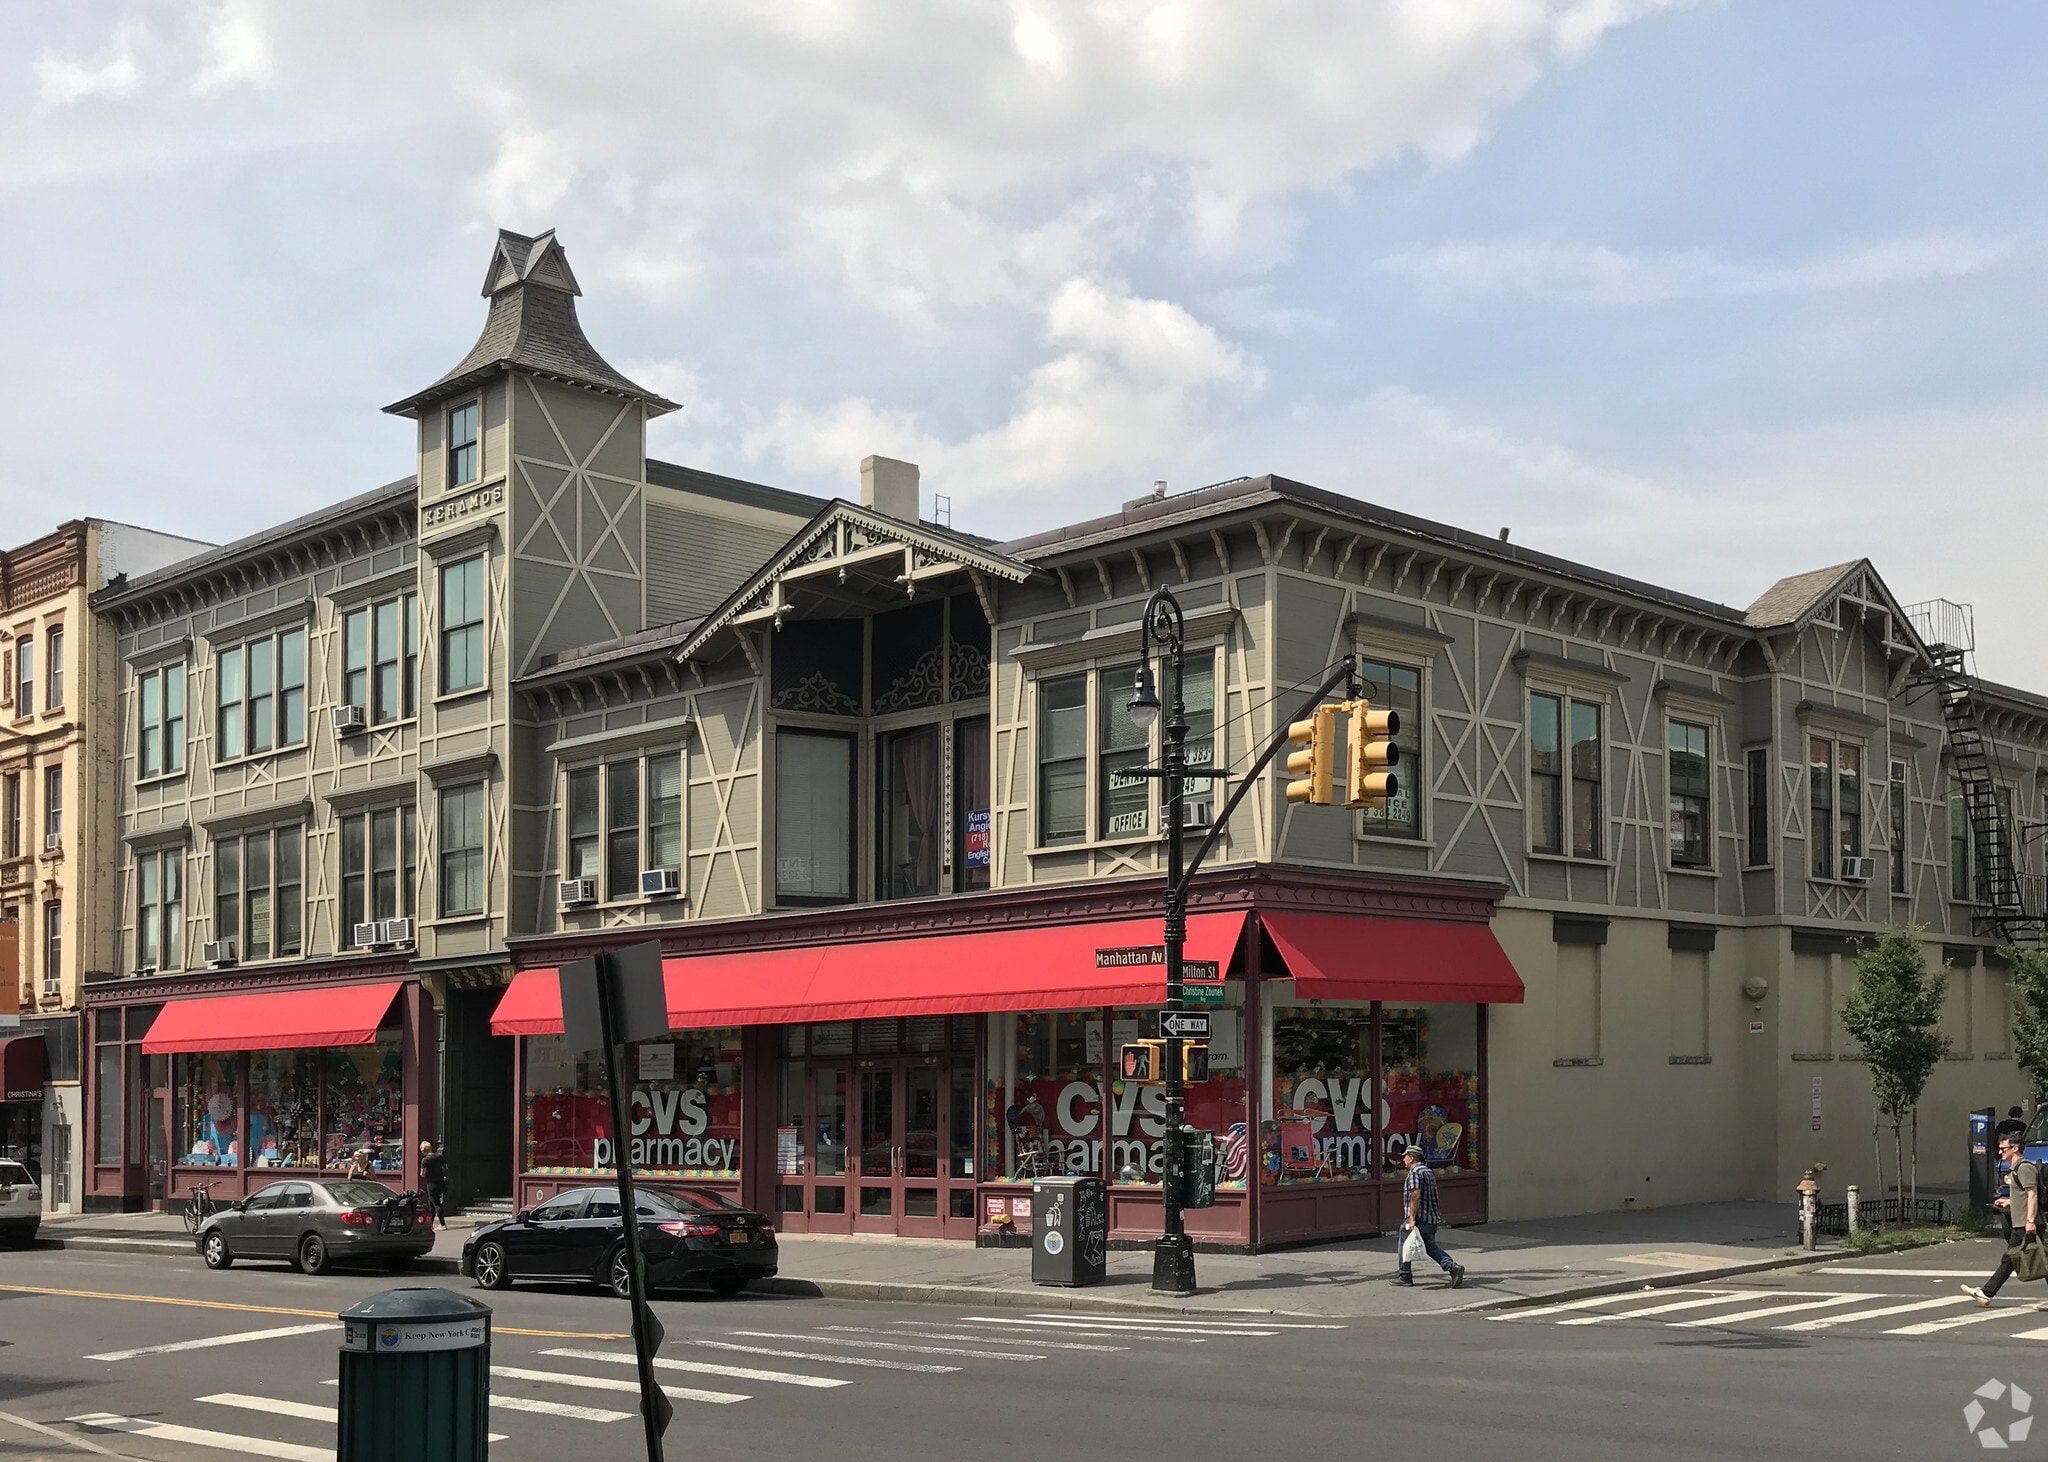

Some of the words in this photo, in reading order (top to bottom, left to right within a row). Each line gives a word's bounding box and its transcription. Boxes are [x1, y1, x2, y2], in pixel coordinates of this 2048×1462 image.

[425, 486, 502, 524] KERAMOS
[1114, 812, 1142, 832] OFFICE
[971, 832, 989, 844] (718)
[1096, 951, 1148, 966] Manhattan
[1151, 951, 1163, 963] Av
[1182, 965, 1206, 978] Milton
[1208, 966, 1216, 978] St
[1182, 985, 1204, 996] Christine
[1169, 1019, 1185, 1030] ONE
[1190, 1020, 1205, 1030] WAY
[7, 1090, 43, 1098] CHRISTINA'S
[632, 1089, 708, 1135] CVS
[1057, 1081, 1166, 1138] CVS
[1293, 1078, 1391, 1134] CVS
[594, 1137, 735, 1170] parmacy
[405, 1331, 427, 1341] Keep
[428, 1331, 446, 1339] New
[448, 1329, 464, 1338] York
